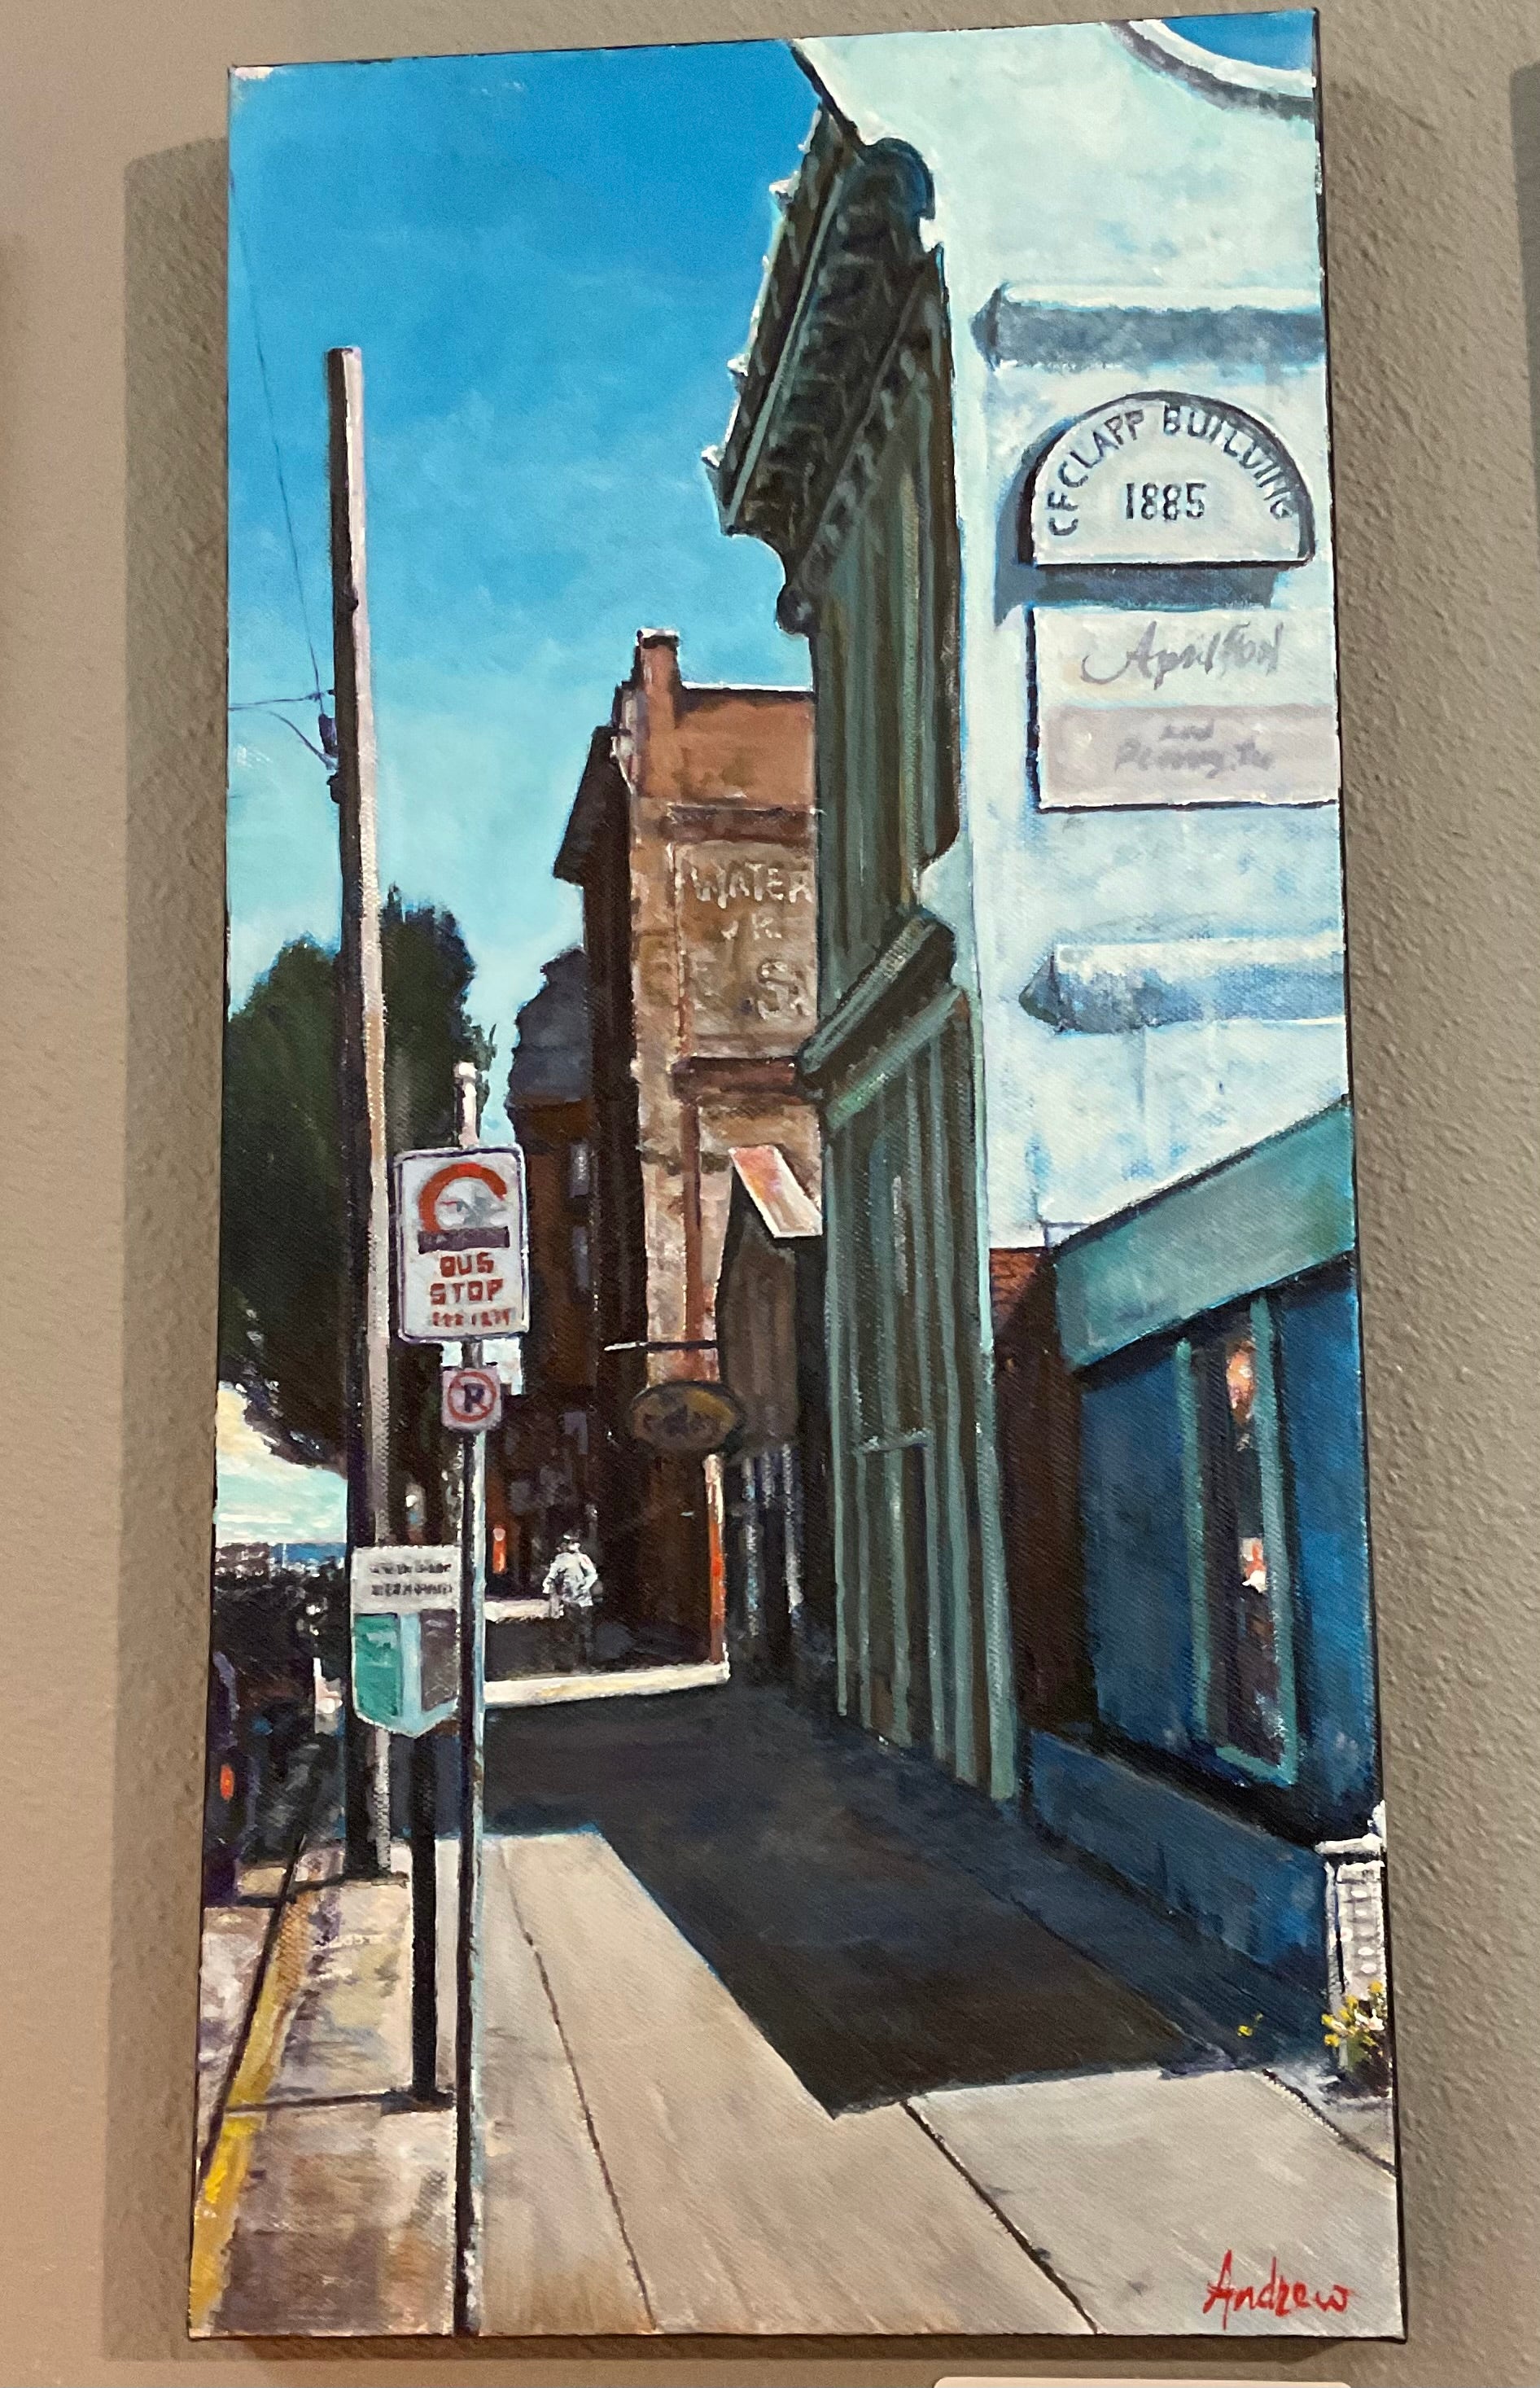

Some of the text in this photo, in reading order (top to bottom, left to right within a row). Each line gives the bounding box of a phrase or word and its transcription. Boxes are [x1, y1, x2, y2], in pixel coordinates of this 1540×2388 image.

[1125, 481, 1207, 522] 1885
[440, 1251, 495, 1278] BUS
[430, 1278, 504, 1306] STOP
[1202, 2248, 1354, 2332] Andrew
